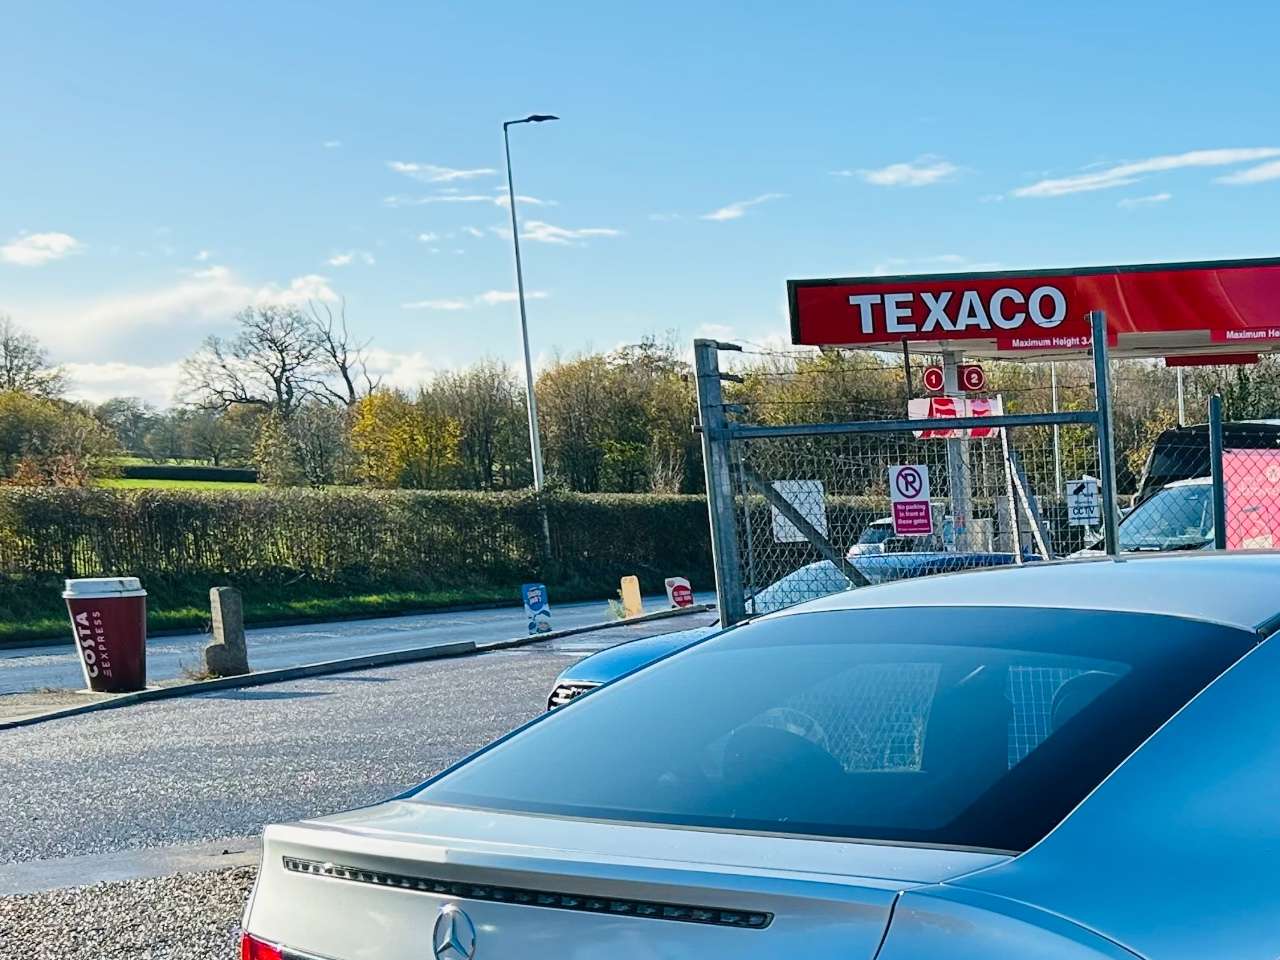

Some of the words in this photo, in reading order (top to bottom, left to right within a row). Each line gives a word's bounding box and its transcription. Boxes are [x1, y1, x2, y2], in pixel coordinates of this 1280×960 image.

[849, 286, 1067, 334] TEXACO
[1226, 330, 1266, 339] Maximum
[1012, 338, 1052, 347] Maximum
[1052, 336, 1080, 348] Height
[970, 373, 979, 384] 2
[905, 503, 926, 512] parking
[1072, 506, 1095, 516] CCTV
[76, 611, 99, 678] COSTA
[92, 611, 111, 668] EXPRESS
